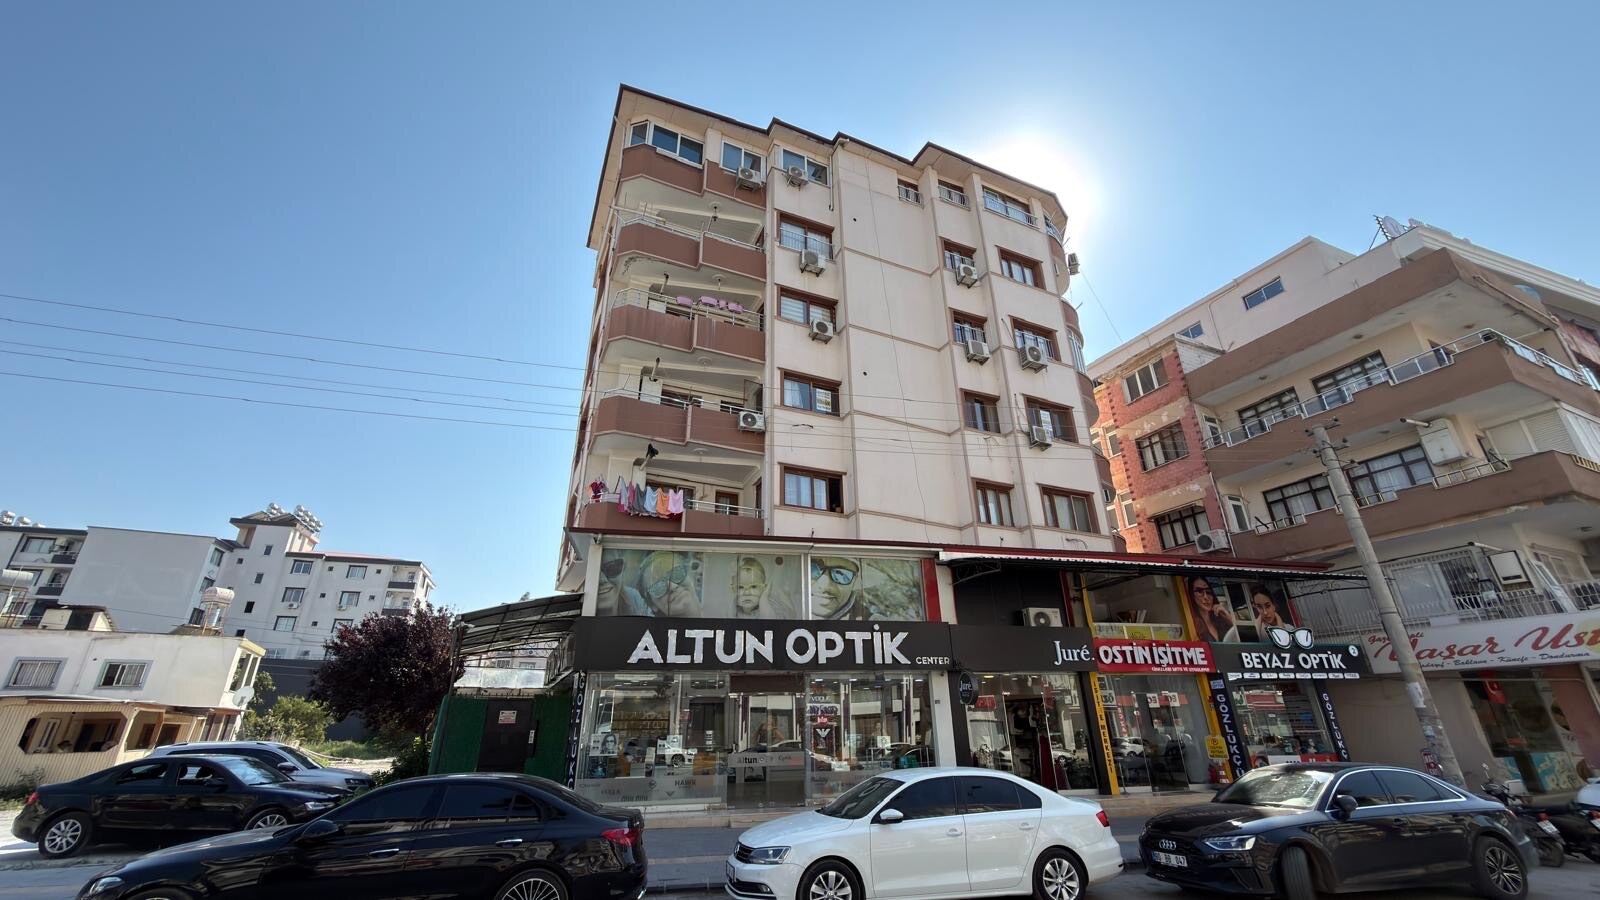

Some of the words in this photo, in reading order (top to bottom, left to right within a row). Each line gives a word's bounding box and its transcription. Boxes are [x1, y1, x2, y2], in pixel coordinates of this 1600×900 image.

[626, 628, 774, 664] ALTUN
[785, 624, 911, 665] OPTİK
[915, 656, 950, 665] CENTER
[1098, 642, 1152, 665] OSTİN
[1152, 642, 1208, 667] İŞİTME
[1241, 652, 1295, 669] BEYAZ
[1298, 651, 1347, 669] OPTİK
[1539, 652, 1590, 660] Dondurma
